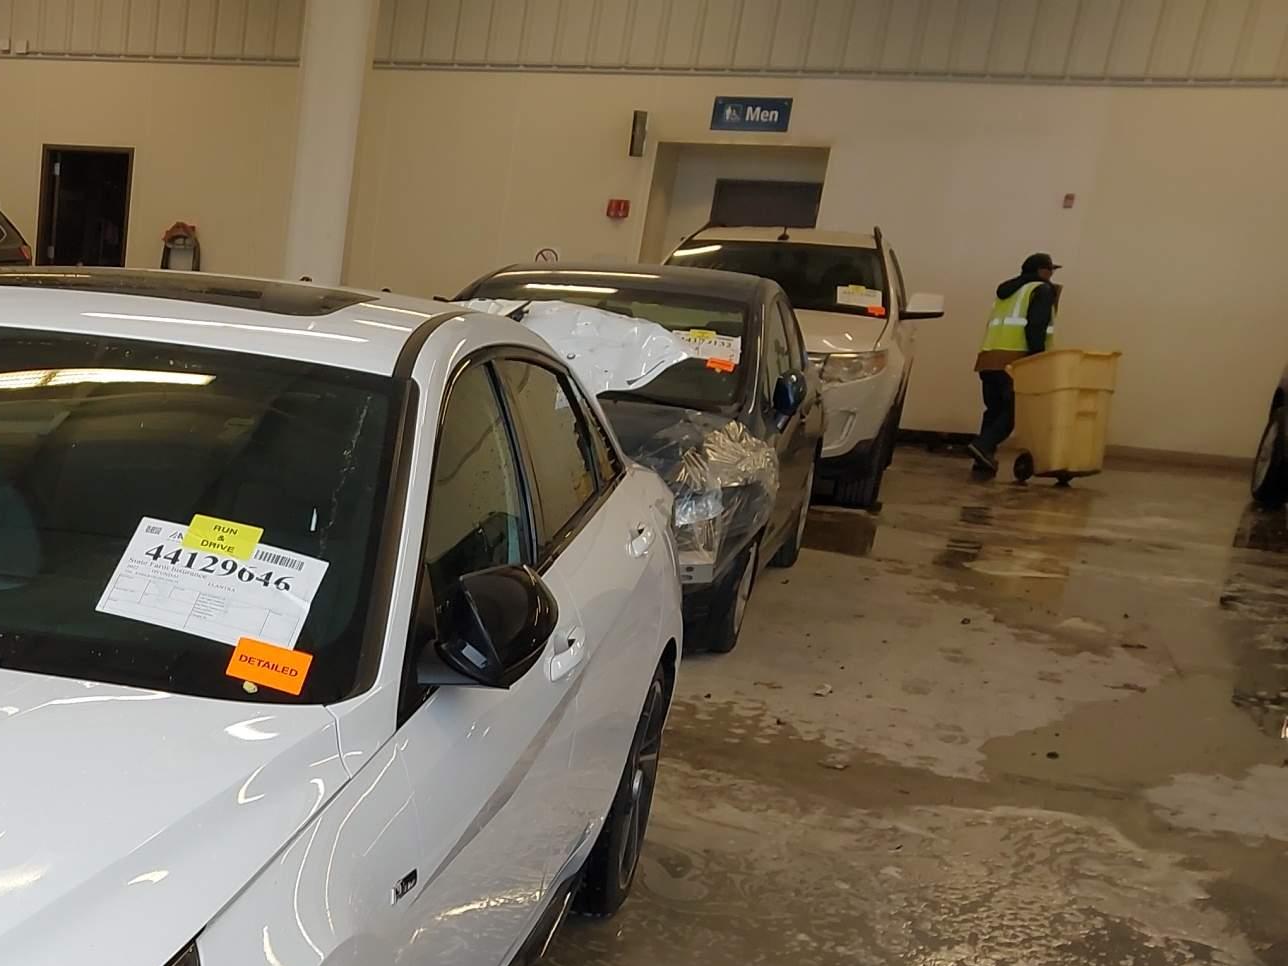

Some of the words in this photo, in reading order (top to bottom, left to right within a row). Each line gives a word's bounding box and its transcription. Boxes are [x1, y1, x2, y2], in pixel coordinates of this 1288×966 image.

[745, 106, 779, 123] Men
[213, 524, 239, 535] RUN
[200, 539, 235, 554] DRIVE
[145, 544, 296, 592] 44129646
[239, 654, 299, 678] DETAILED
